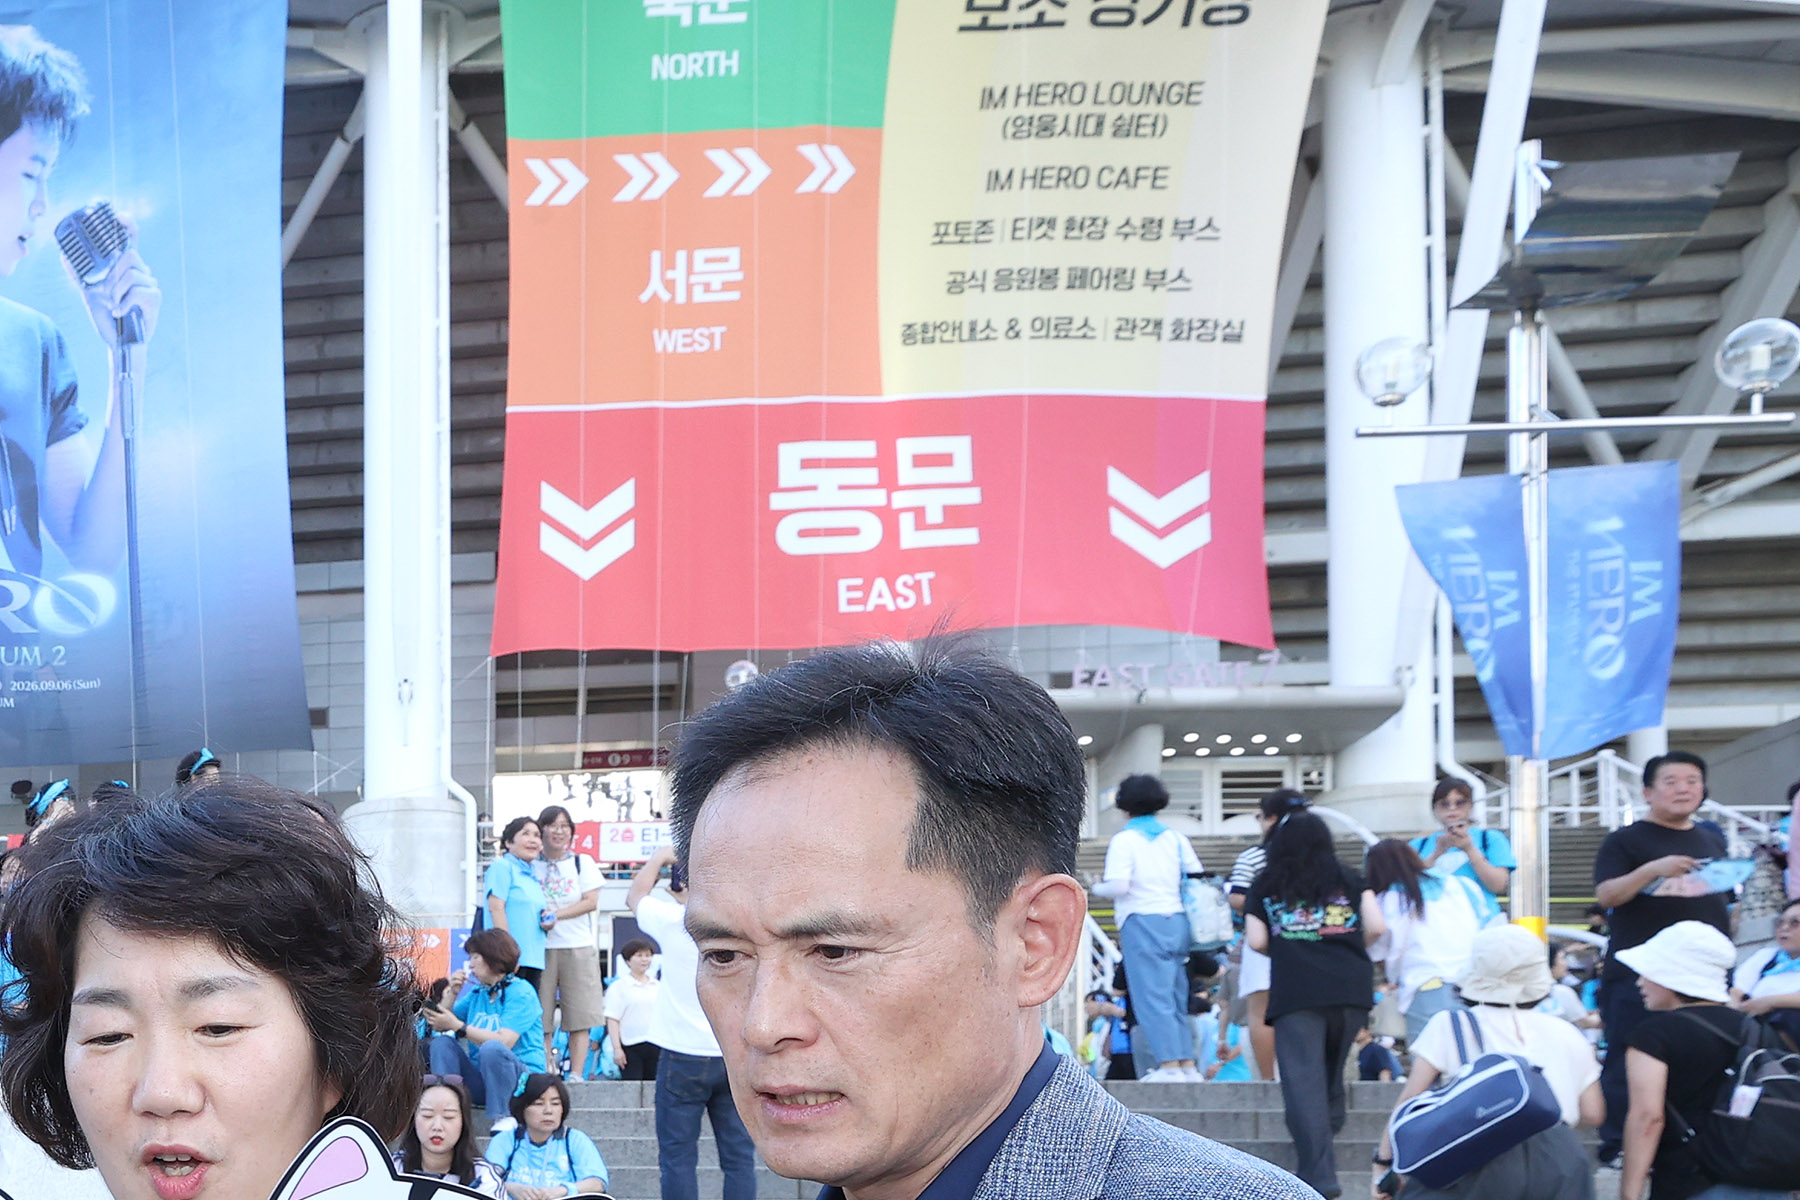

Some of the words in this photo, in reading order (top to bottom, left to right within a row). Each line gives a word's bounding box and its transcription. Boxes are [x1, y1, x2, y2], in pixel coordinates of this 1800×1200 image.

[651, 49, 740, 81] NORTH
[980, 86, 1009, 110] IM
[1014, 82, 1088, 108] HERO
[1093, 80, 1206, 106] LOUNGE
[1002, 112, 1106, 140] (영웅시대
[1112, 112, 1168, 139] 쉼터)
[986, 167, 1013, 193] IM
[1019, 166, 1091, 190] HERO
[1097, 165, 1171, 190] CAFE
[930, 218, 995, 246] 포토존
[1011, 215, 1058, 242] 티켓
[1063, 215, 1109, 242] 현장
[1115, 215, 1165, 243] 수령
[1171, 215, 1222, 243] 부스
[638, 246, 745, 307] 서문
[946, 268, 988, 295] 공식
[993, 266, 1061, 293] 응원봉
[1065, 266, 1137, 293] 페어링
[1142, 266, 1194, 293] 부스
[652, 325, 728, 355] WEST
[1004, 318, 1022, 341] &
[1028, 316, 1098, 342] 의료소
[1114, 316, 1164, 342] 관객
[1168, 317, 1247, 344] 화장실
[767, 433, 984, 558] 동문
[836, 570, 937, 614] EAST
[52, 644, 67, 667] 2
[10, 677, 101, 693] 2026.09.06(Sun)
[1072, 662, 1155, 690] EAST
[1166, 662, 1250, 689] GATE
[1257, 652, 1282, 687] 7
